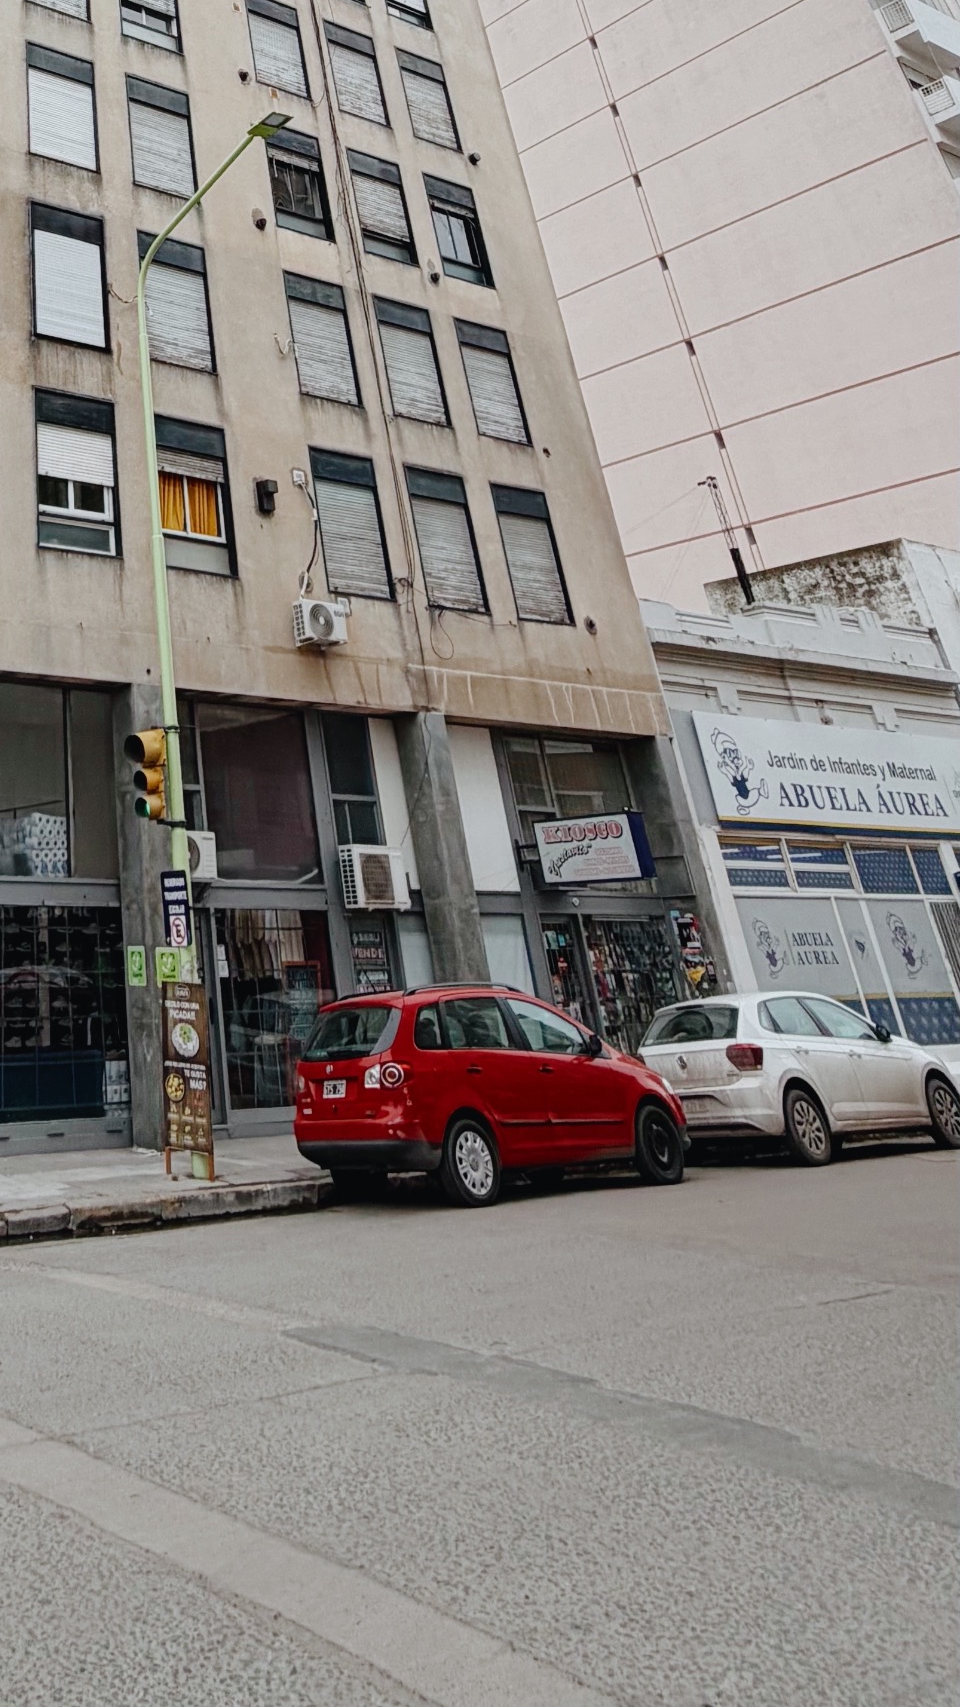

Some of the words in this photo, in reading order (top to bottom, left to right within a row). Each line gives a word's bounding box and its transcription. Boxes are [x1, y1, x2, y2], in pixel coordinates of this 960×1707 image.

[810, 754, 827, 772] de
[828, 756, 877, 777] Infantes
[878, 764, 887, 782] y
[889, 761, 937, 781] Maternal
[779, 782, 873, 813] ABUELA
[877, 784, 949, 818] ÁUREA
[542, 820, 623, 845] KIOSCO
[791, 932, 834, 947] ABUELA
[796, 950, 839, 965] AUREA
